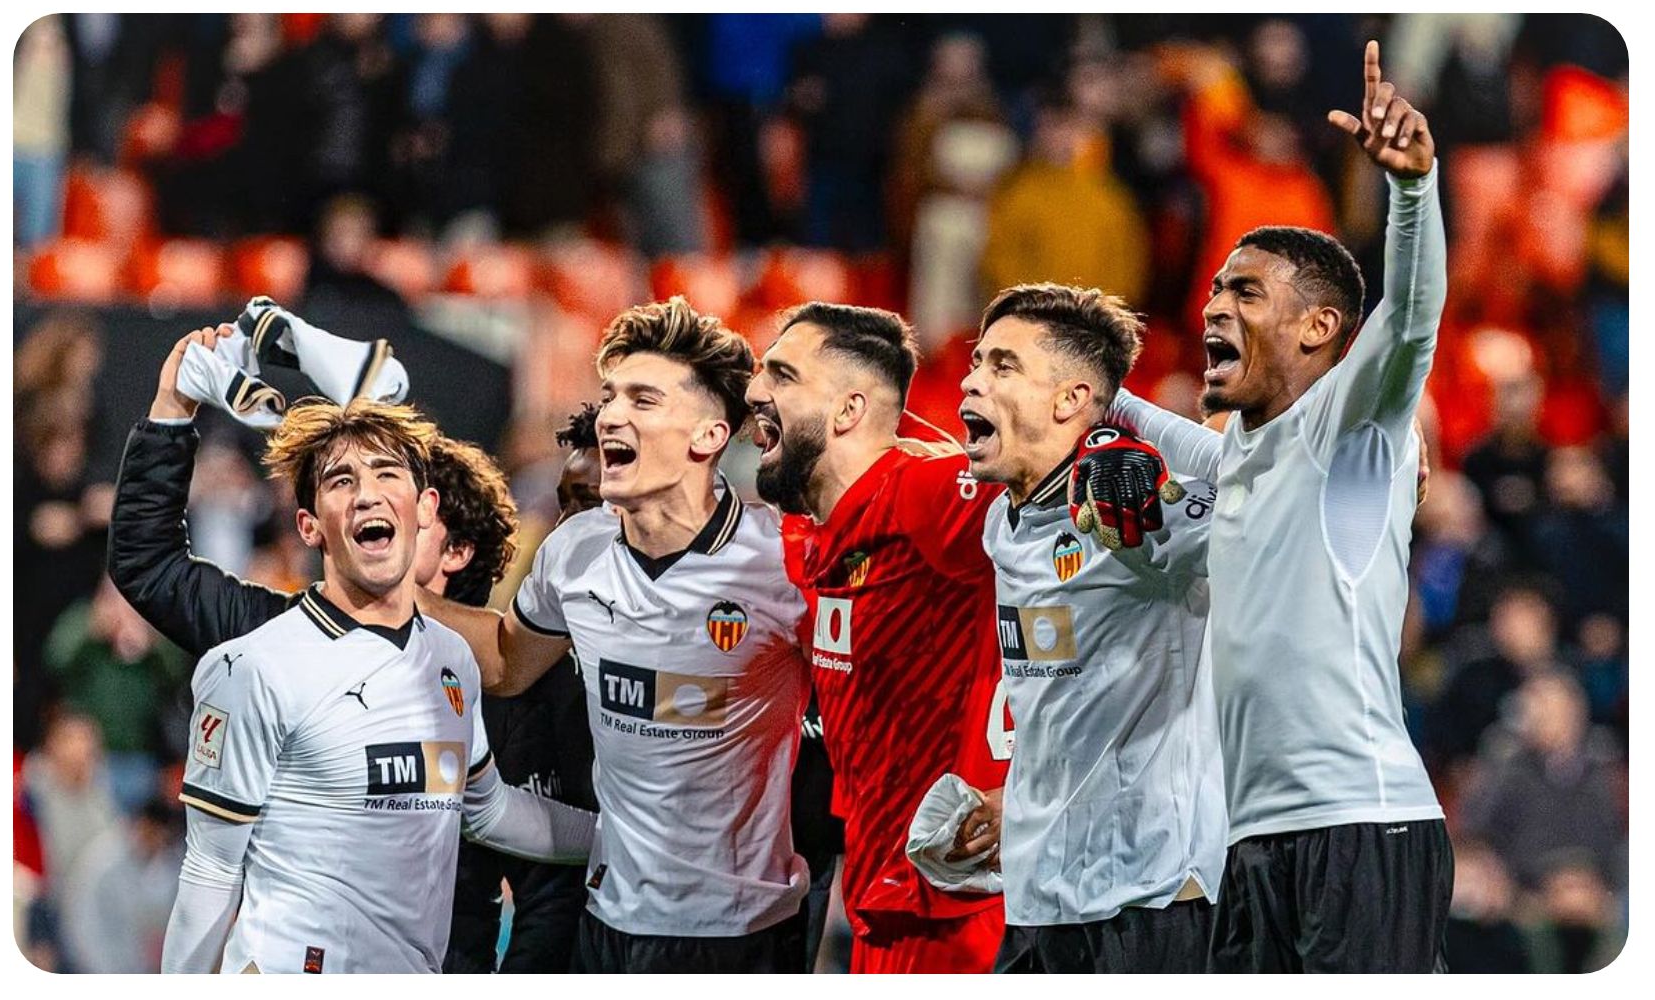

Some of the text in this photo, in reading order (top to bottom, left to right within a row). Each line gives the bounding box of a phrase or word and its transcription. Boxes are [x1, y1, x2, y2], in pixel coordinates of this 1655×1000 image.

[1000, 619, 1020, 649] TM
[1047, 665, 1082, 677] Group
[604, 673, 645, 708] TM
[600, 712, 725, 740] TM Real Estate Group
[375, 755, 417, 785] TM
[364, 798, 384, 809] TM
[386, 798, 413, 811] Real
[414, 798, 444, 811] Estate
